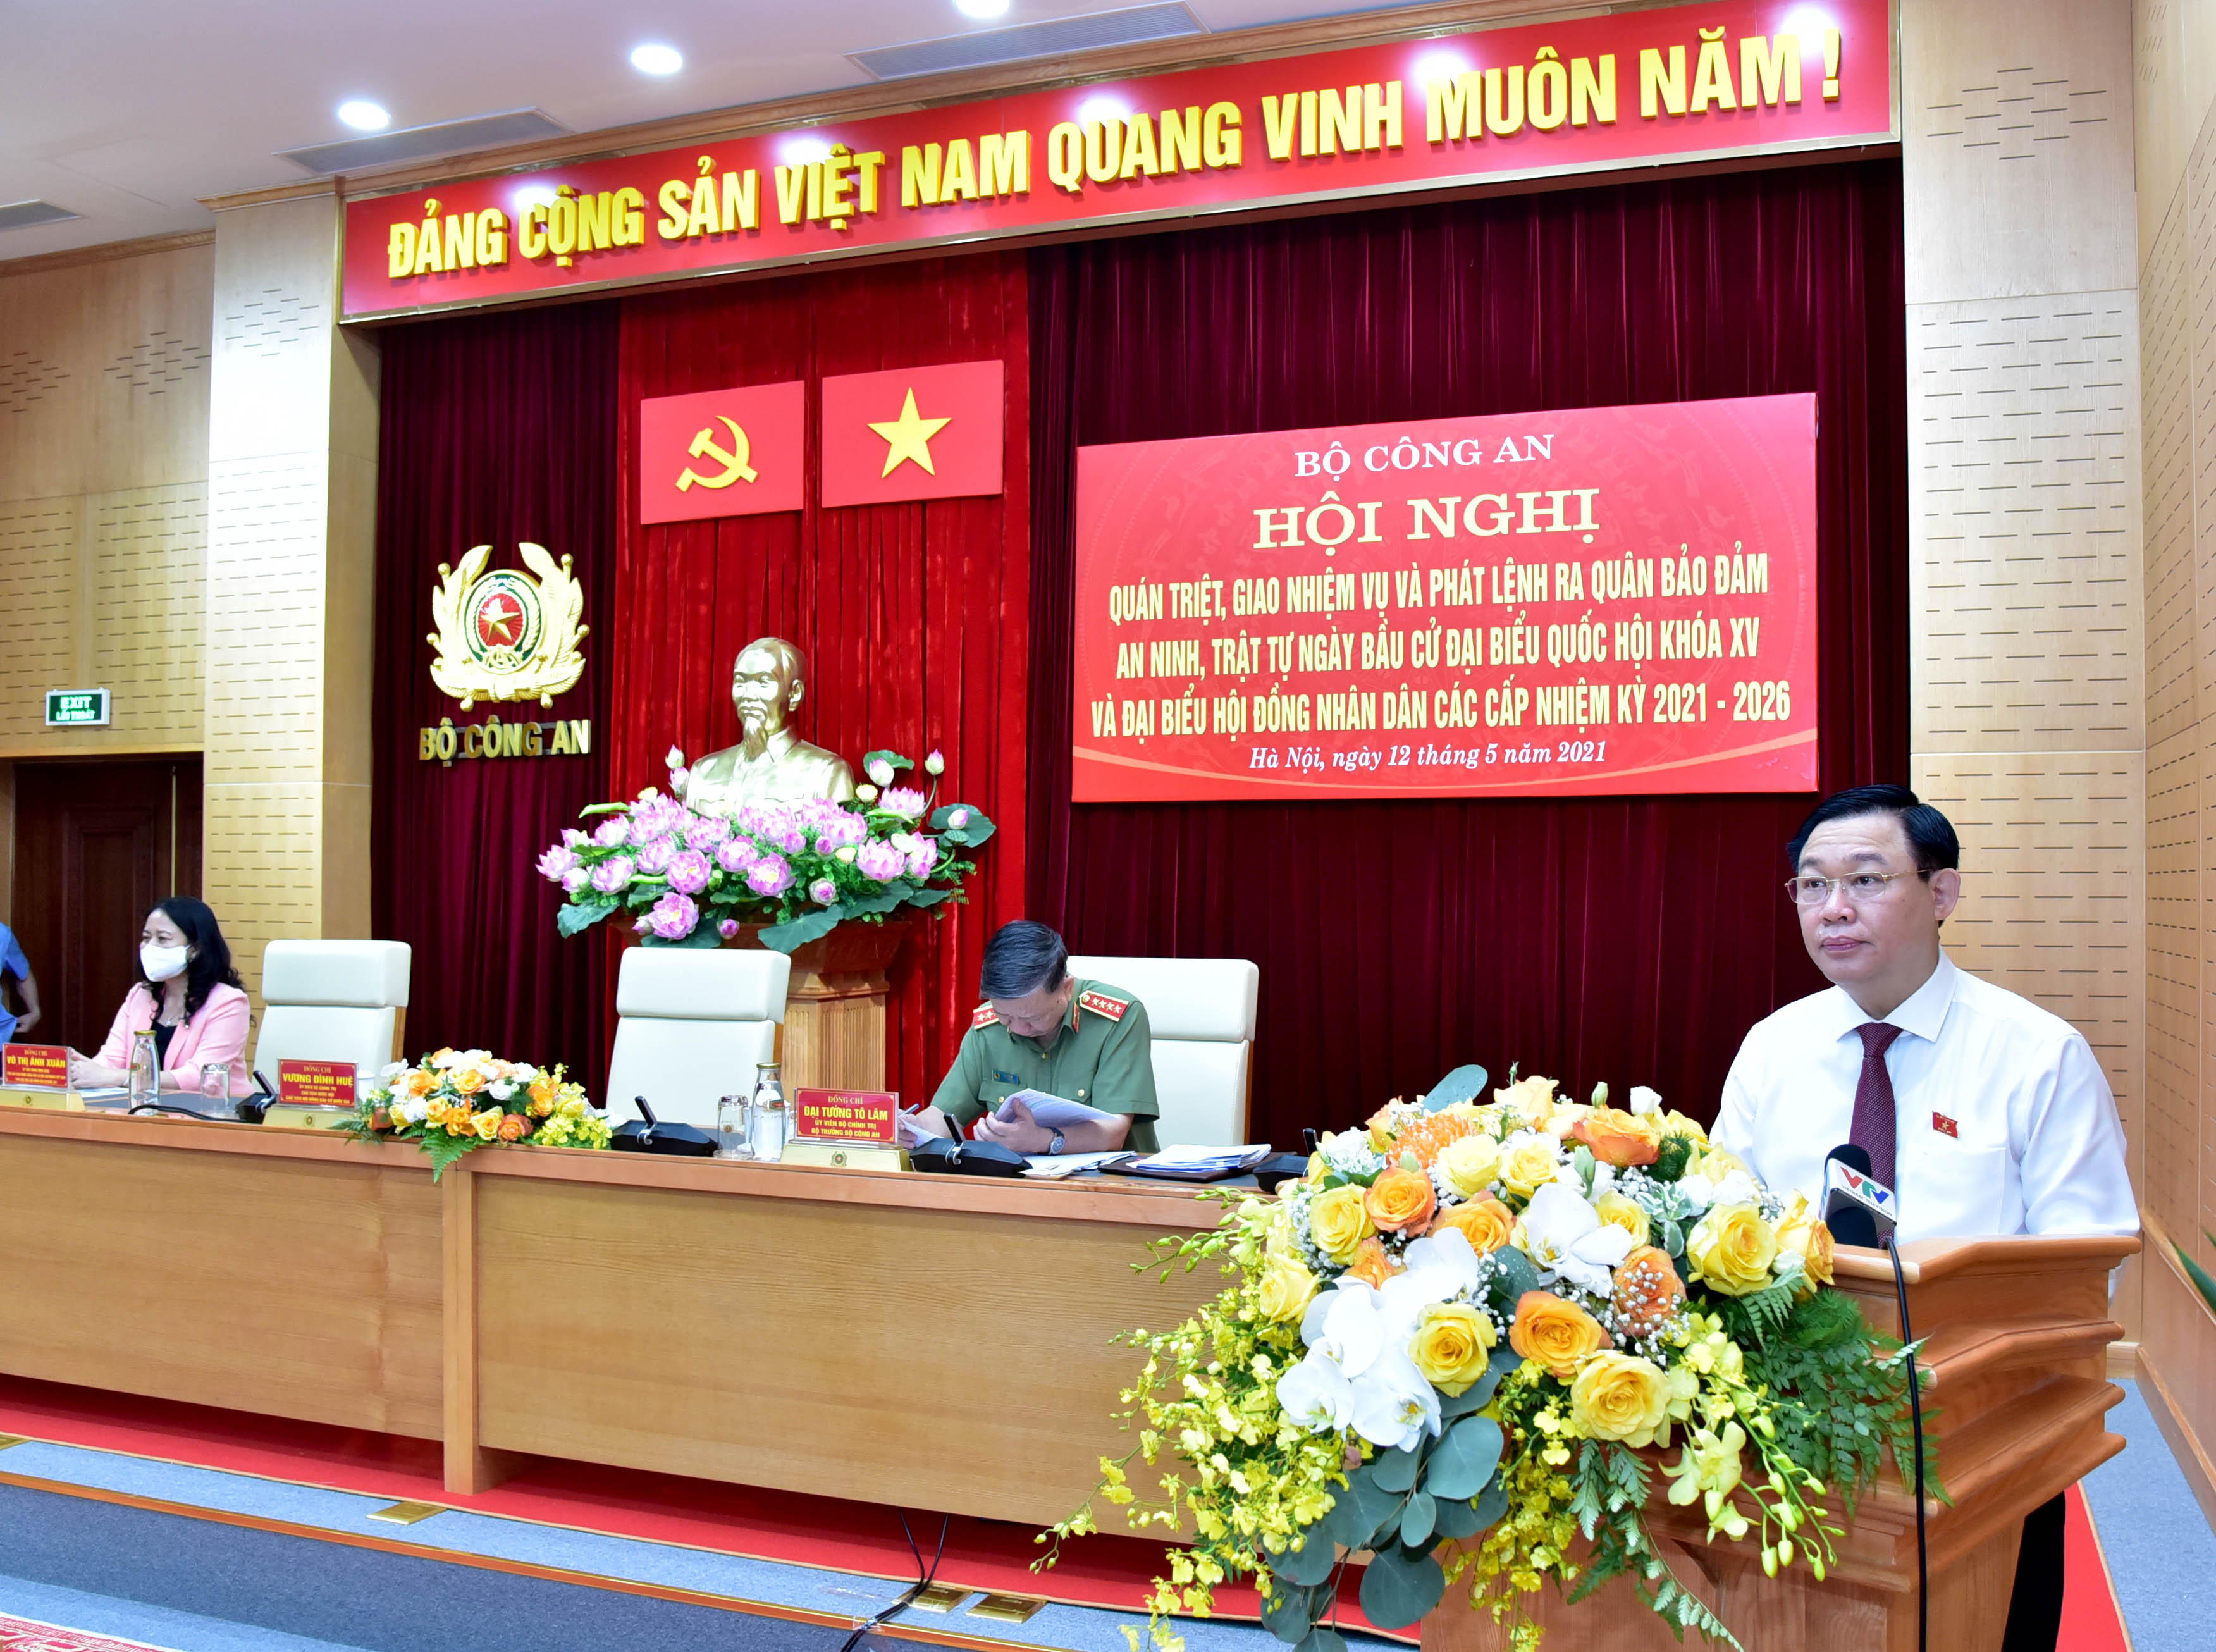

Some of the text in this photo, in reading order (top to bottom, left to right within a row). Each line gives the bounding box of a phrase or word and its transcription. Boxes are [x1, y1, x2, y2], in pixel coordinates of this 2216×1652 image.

[388, 198, 508, 278] ĐẢNG
[519, 184, 645, 268] CỘNG
[657, 156, 761, 240] SẢN
[775, 142, 885, 230] VIỆT
[901, 129, 1031, 209] NAM
[1047, 101, 1243, 192] QUANG
[1261, 80, 1403, 162] VINH
[1425, 46, 1618, 145] MUÔN
[1639, 26, 1803, 119] NĂM
[1295, 434, 1554, 482] BỘ CÔNG AN
[1253, 488, 1600, 557] HỘI NGHỊ
[1109, 541, 1769, 626] QUÁN TRIỆT, GIAO NHIỆM VỤ VÀ PHÁT LỆNH RA QUÂN BẢO ĐẢM
[1116, 609, 1760, 682] AN NINH, TRẬT TỰ NGÀY BẦU CỬ ĐẠI BIỂU QUỐC HỘI KHÓA XV
[60, 696, 92, 709] EXIT
[1091, 693, 1117, 737] VÀ
[1121, 699, 1155, 744] ĐẠI
[1161, 683, 1207, 736] BIỂU
[1213, 689, 1247, 742] HỘI
[1253, 682, 1310, 733] ĐỒNG
[1317, 685, 1376, 732] NHÂN
[1383, 683, 1428, 729] DÂN
[1434, 681, 1478, 729] CÁC
[1484, 674, 1529, 727] CẤP
[1536, 677, 1610, 734] NHIỆM
[1617, 675, 1647, 724] KỲ
[1653, 682, 1707, 724] 2021
[1733, 681, 1791, 722] 2026
[419, 715, 591, 767] BỘ CÔNG AN
[1249, 741, 1606, 774] Hà Nội, ngày 12 tháng 5 năm 2021
[283, 1073, 354, 1088] VƯƠNG ĐÌNH HUỆ
[828, 1094, 863, 1105] ĐỒNG CHÍ
[804, 1104, 888, 1121] ĐẠI TƯỚNG TÔ LÂM
[811, 1127, 820, 1135] BỘ
[821, 1126, 843, 1136] TRƯỞNG
[845, 1128, 853, 1137] BỘ
[854, 1129, 870, 1137] CÔNG
[815, 1118, 822, 1126] ỦY
[824, 1119, 837, 1127] VIÊN
[839, 1120, 846, 1128] BỘ
[848, 1120, 866, 1128] CHÍNH
[1840, 1166, 1890, 1205] VTV
